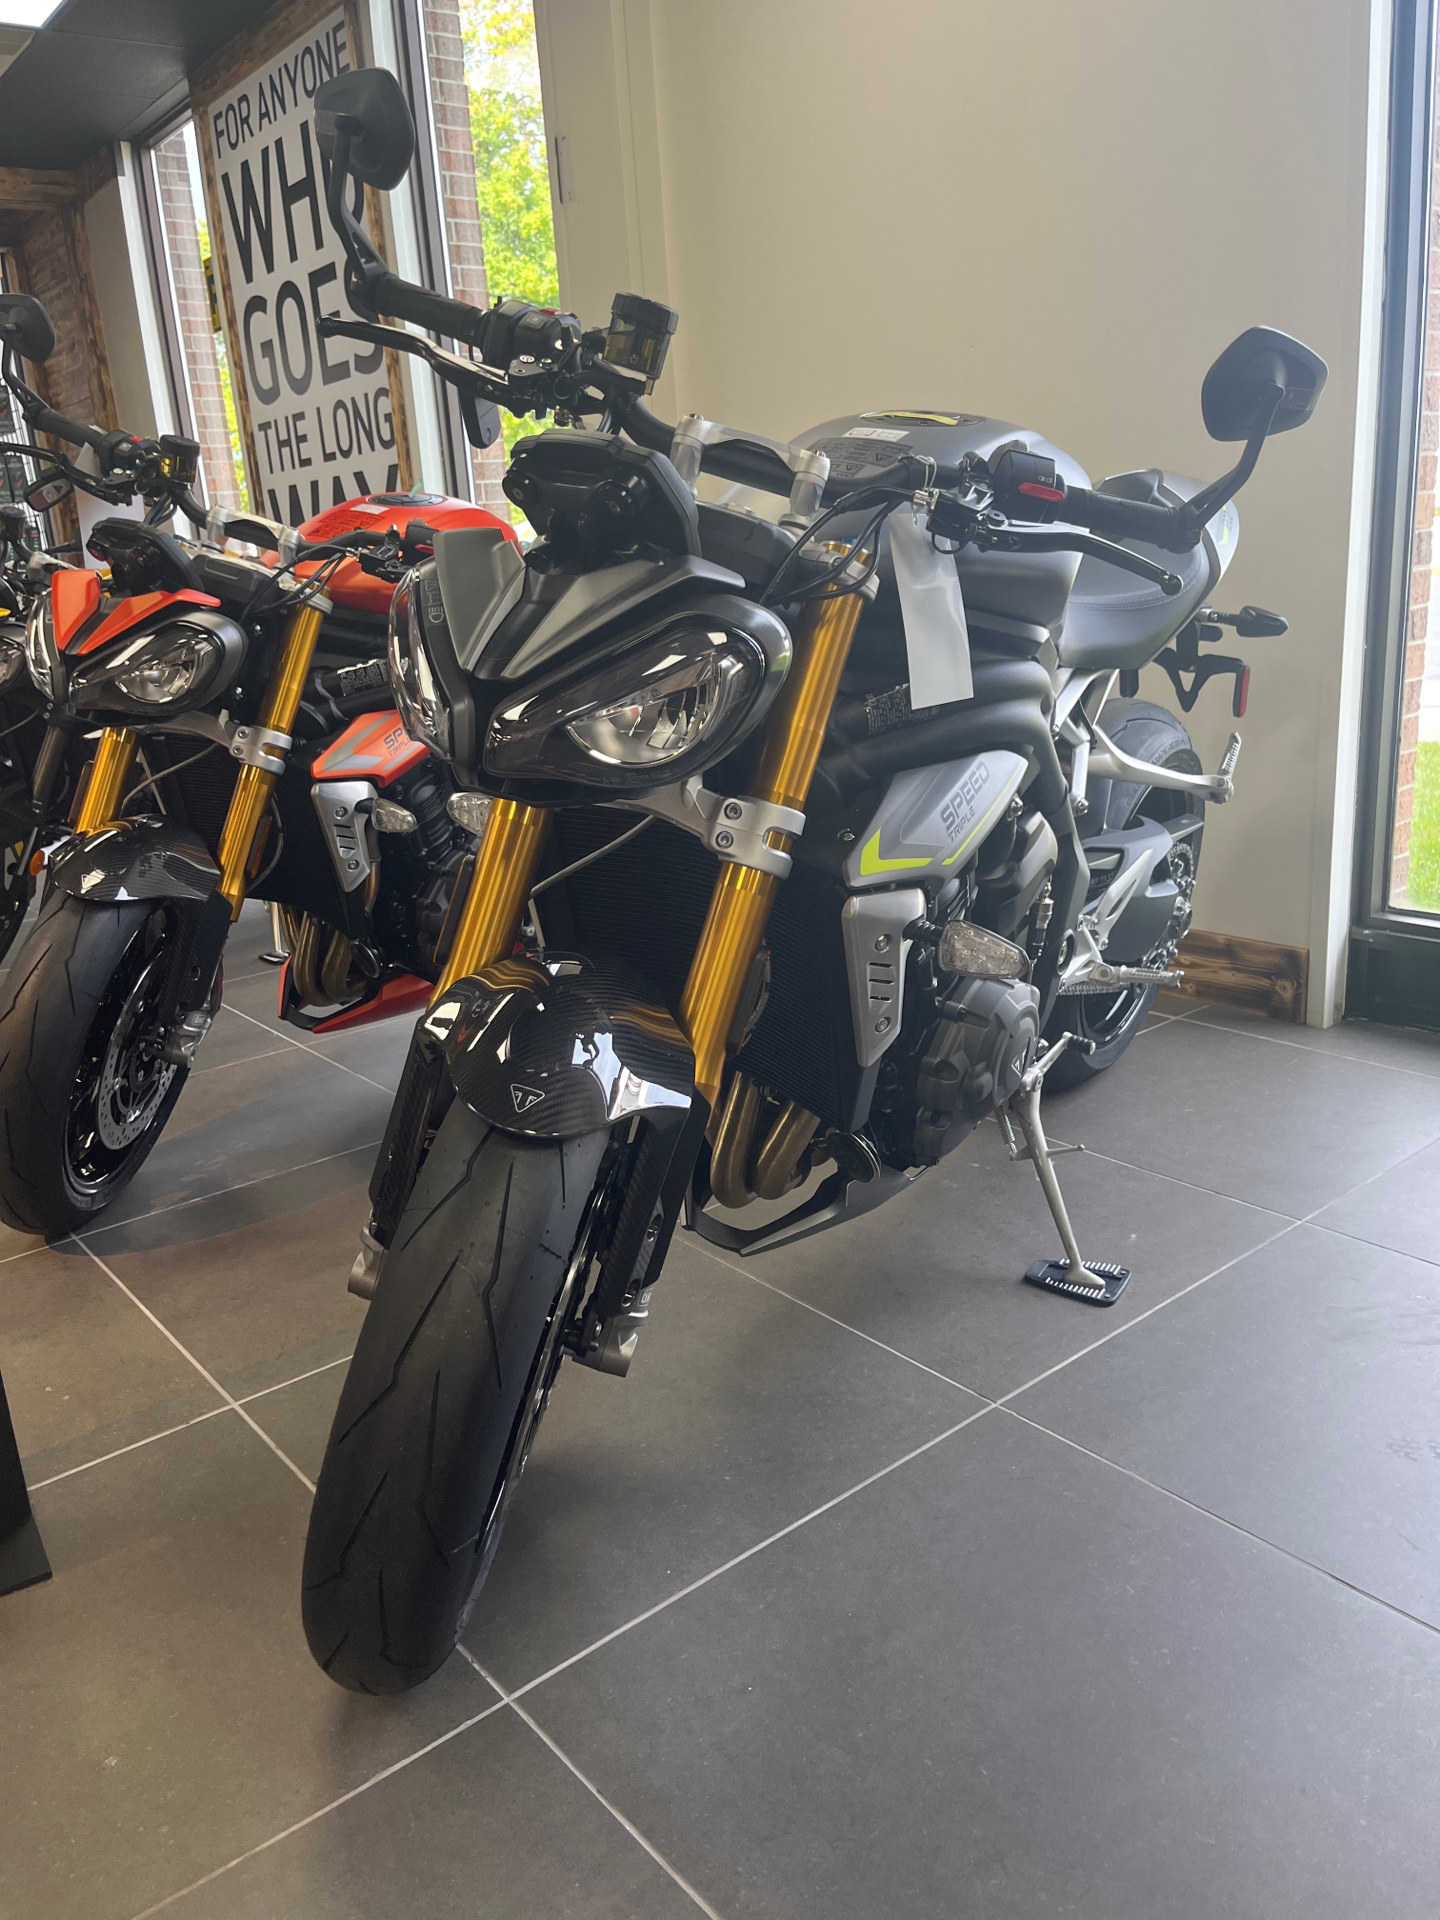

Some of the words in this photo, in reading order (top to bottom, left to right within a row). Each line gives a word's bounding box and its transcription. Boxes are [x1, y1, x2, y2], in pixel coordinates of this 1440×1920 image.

[213, 93, 255, 160] FOR
[258, 19, 350, 133] ANYONE
[243, 256, 384, 406] GOES
[258, 411, 312, 475] THE
[316, 386, 396, 464] LONG
[940, 760, 991, 832] SPEED
[948, 805, 976, 843] TRIPLE
